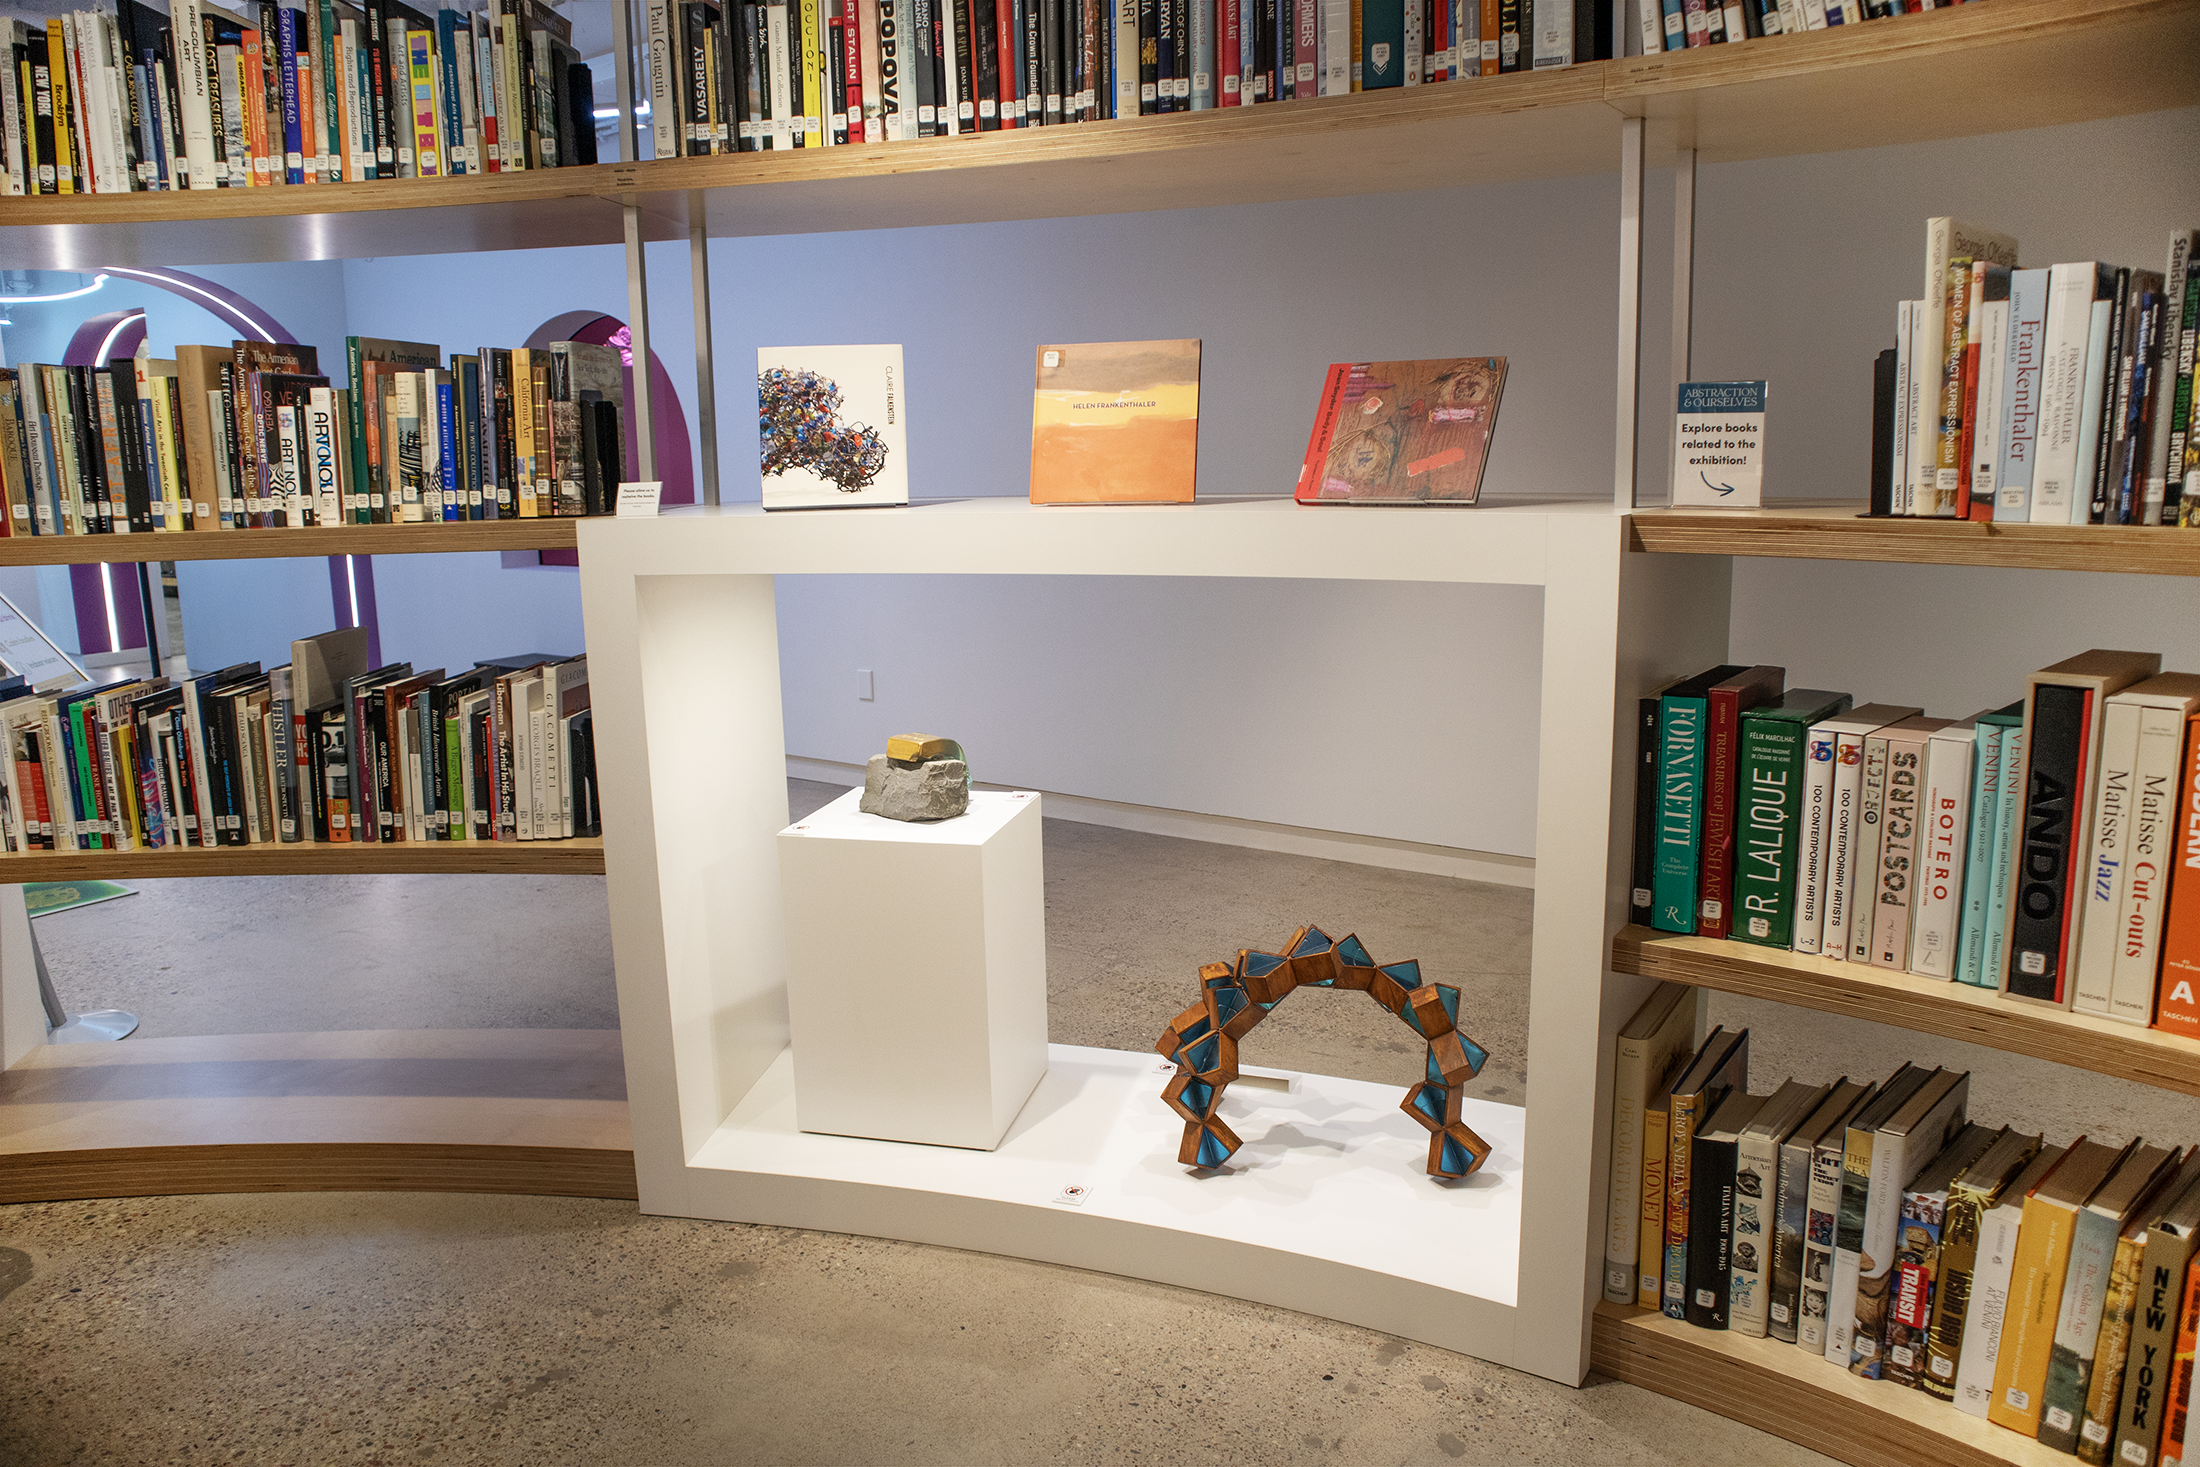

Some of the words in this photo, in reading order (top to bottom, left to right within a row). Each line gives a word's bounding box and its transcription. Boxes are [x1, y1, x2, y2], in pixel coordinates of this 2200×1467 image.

[279, 9, 293, 58] GRAPHIS
[650, 5, 664, 35] Paul
[1028, 12, 1037, 29] The
[183, 40, 191, 62] ART
[188, 5, 204, 97] PRE-COLUMBIAN
[205, 43, 217, 72] LOST
[346, 46, 356, 72] Rights
[397, 44, 406, 58] Art
[410, 35, 429, 79] THE
[848, 28, 856, 79] STALIN
[880, 0, 898, 115] POPOVA
[1029, 30, 1038, 58] Crown
[35, 66, 48, 87] NEW
[347, 73, 355, 88] and
[398, 59, 407, 76] and
[652, 38, 668, 98] Gauguin
[693, 46, 706, 118] VASARELY
[1030, 60, 1039, 95] Fountain
[36, 91, 52, 116] YORK
[55, 84, 64, 127] Brooklyn
[207, 74, 224, 137] TREASURES
[283, 61, 296, 123] LETTERHEAD
[400, 78, 409, 107] Artists
[414, 84, 434, 128] ART
[349, 90, 359, 146] Reproductions
[2169, 238, 2187, 298] Stanislav
[1952, 267, 1965, 308] WOMEN
[1951, 310, 1963, 324] OF
[236, 348, 244, 364] The
[1949, 325, 1962, 379] ABSTRACT
[237, 366, 248, 407] Armenian
[885, 366, 894, 392] CLAIRE
[1335, 368, 1345, 385] Joan
[1897, 361, 1907, 399] ABSTRACT
[2009, 319, 2041, 462] Frankenthaler
[521, 377, 530, 421] California
[887, 393, 895, 425] FALKENSTEIN
[1097, 401, 1156, 409] FRANKENTHALER
[1329, 386, 1341, 411] Snyder
[1684, 398, 1692, 407] &
[1693, 397, 1758, 407] OURSELVES
[1685, 388, 1758, 398] ABSTRACTION
[1910, 381, 1920, 420] ABSTRACT
[2061, 347, 2080, 444] FRANKENTHALER
[522, 423, 530, 439] Art
[1322, 411, 1333, 429] Body
[1682, 423, 1722, 435] Explore
[1725, 423, 1758, 432] books
[1895, 400, 1906, 457] EXPRESSIONISM
[1909, 421, 1918, 436] ART
[1943, 380, 1959, 463] EXPRESSIONISM
[1316, 436, 1326, 453] Soul
[1682, 439, 1721, 448] related
[1724, 440, 1735, 448] to
[1738, 439, 1756, 448] the
[246, 463, 253, 473] of
[1689, 456, 1747, 465] exhibition!
[247, 474, 255, 488] the
[496, 683, 505, 725] Liberman
[271, 690, 287, 768] WHISTLER
[498, 730, 507, 746] The
[546, 693, 556, 788] GIACOMETTI
[500, 747, 509, 771] Artist
[1713, 731, 1727, 793] TREASURES
[1982, 731, 2002, 793] VENINI
[501, 772, 509, 780] In
[501, 781, 510, 795] His
[1662, 706, 1697, 847] FORNASETTI
[1713, 795, 1724, 810] OF
[1813, 784, 1823, 802] 100
[1841, 788, 1851, 807] 100
[2099, 769, 2129, 849] Matisse
[1746, 767, 1789, 882] LALIQUE
[1978, 794, 1991, 828] Catalogue
[2137, 775, 2168, 855] Matisse
[1706, 812, 1726, 871] JEWISH
[1807, 805, 1822, 882] CONTEMPORARY
[1835, 809, 1850, 888] CONTEMPORARY
[1932, 798, 1956, 901] BOTERO
[2021, 769, 2068, 921] ANDO
[2094, 853, 2120, 903] Jazz
[1744, 892, 1779, 914] R.
[1804, 883, 1816, 922] ARTISTS
[1832, 889, 1844, 927] ARTISTS
[2124, 860, 2157, 958] Cut-outs
[1969, 926, 1981, 960] Allemandi
[1990, 930, 2002, 963] Allemandi
[2078, 991, 2108, 1003] TASCHEN
[2114, 1000, 2145, 1011] TASCHEN
[2169, 981, 2195, 1004] A
[1613, 1096, 1636, 1207] DECORATIVE
[1739, 1152, 1772, 1164] Armenian
[1758, 1162, 1771, 1171] Art
[1780, 1155, 1790, 1178] Karl
[1847, 1152, 1870, 1165] THE
[1845, 1163, 1868, 1178] SEA
[1642, 1157, 1662, 1227] MONET
[1721, 1185, 1731, 1216] ITALIAN
[1776, 1179, 1789, 1222] Bodmer's
[1611, 1212, 1629, 1254] ARTS
[1719, 1217, 1730, 1234] ART
[1773, 1228, 1786, 1268] America
[2084, 1263, 2099, 1282] The
[1899, 1268, 1920, 1324] TRANSIT
[1987, 1286, 1995, 1299] AT
[1992, 1289, 2005, 1320] FULVIO
[2078, 1284, 2094, 1316] Golden
[2146, 1266, 2170, 1332] NEW
[1981, 1299, 1994, 1329] VENINI
[2074, 1319, 2087, 1337] Age
[1985, 1321, 2001, 1362] BIANCONI
[2132, 1345, 2158, 1430] YORK
